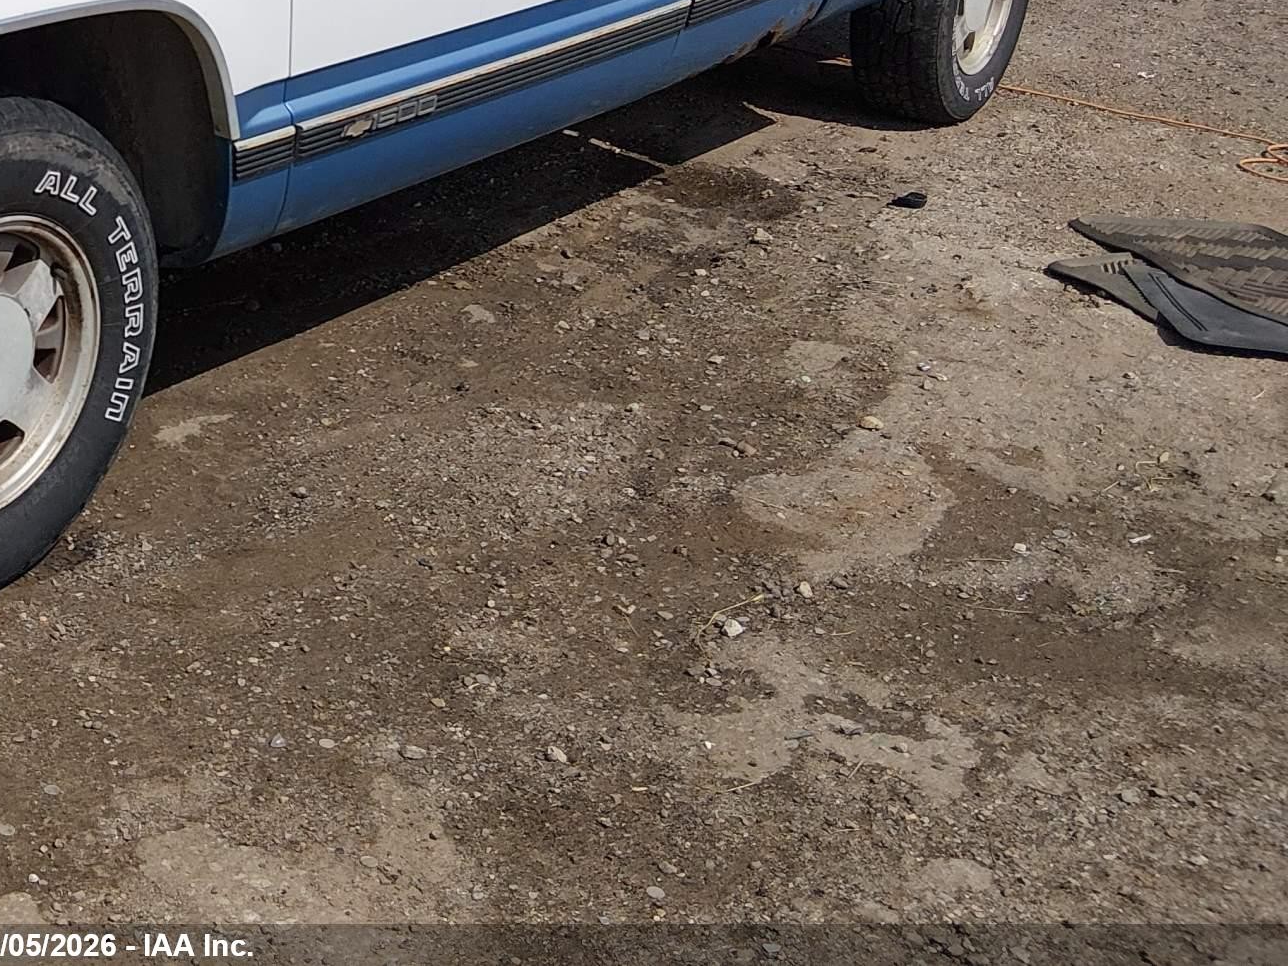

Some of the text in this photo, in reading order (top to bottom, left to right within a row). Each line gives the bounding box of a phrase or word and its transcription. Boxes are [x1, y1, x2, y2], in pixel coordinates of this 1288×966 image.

[372, 94, 438, 131] 1500
[34, 170, 144, 422] ALL TERRAIN
